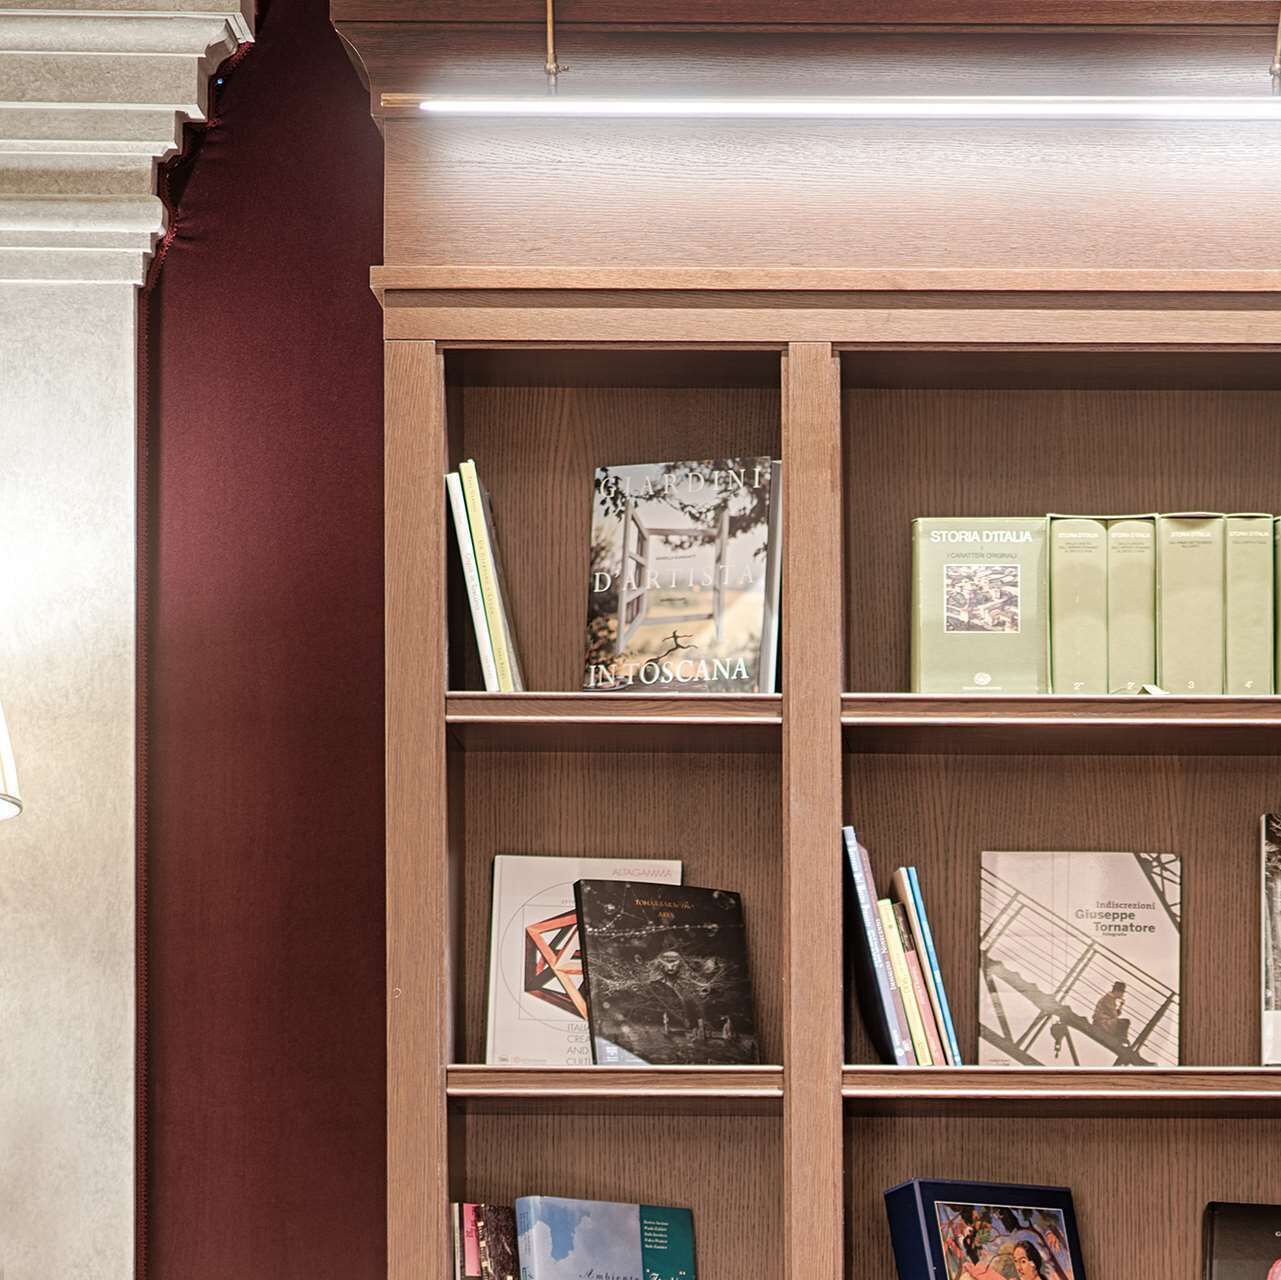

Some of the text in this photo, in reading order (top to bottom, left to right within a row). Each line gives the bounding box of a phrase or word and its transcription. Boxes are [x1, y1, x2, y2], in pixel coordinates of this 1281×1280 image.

[600, 468, 762, 498] GIARDINI
[930, 530, 1033, 542] STORIA D'ITALIA
[594, 565, 754, 594] D'ARTISTA
[589, 657, 750, 688] IN TOSCANA
[1095, 901, 1156, 910] Indiscrezioni
[1075, 909, 1136, 922] Giuseppe
[1093, 921, 1156, 933] Tornatore
